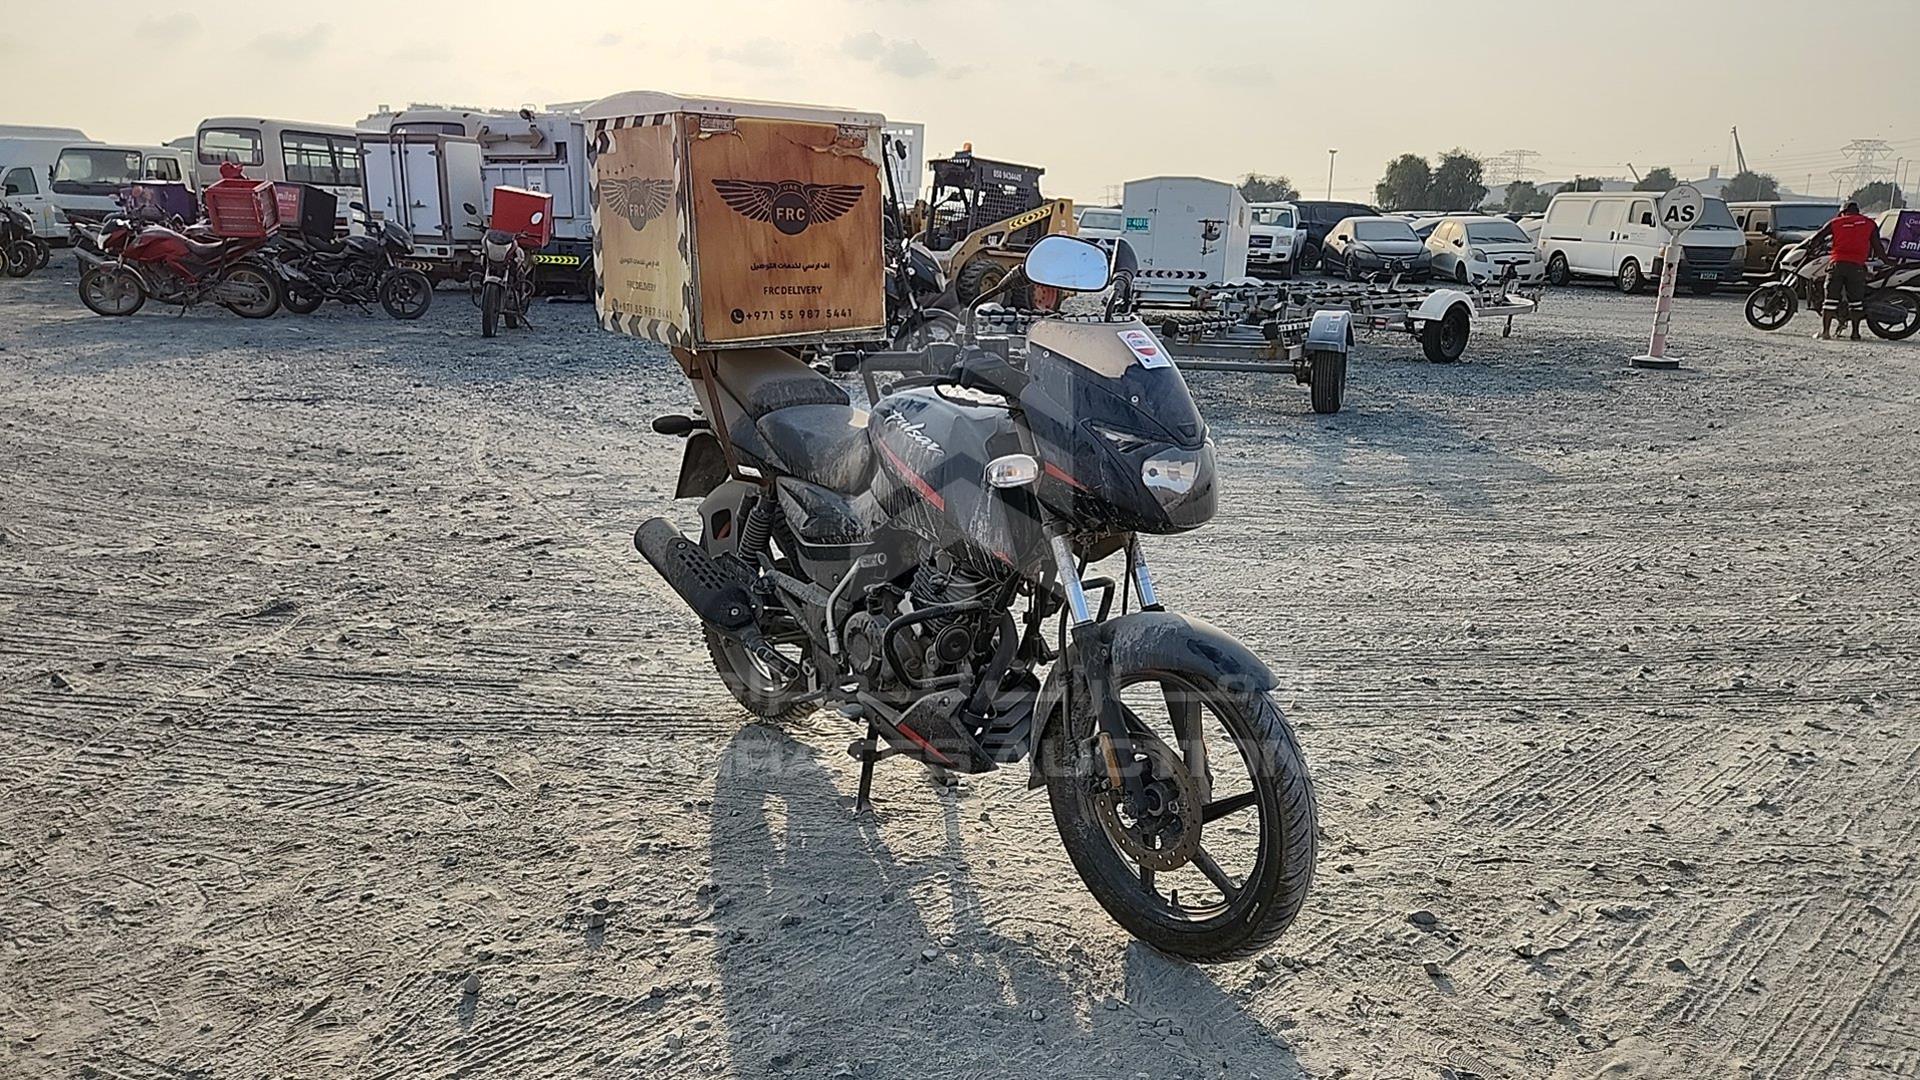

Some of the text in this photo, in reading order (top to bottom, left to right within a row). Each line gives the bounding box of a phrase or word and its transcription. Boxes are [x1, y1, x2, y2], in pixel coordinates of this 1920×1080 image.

[629, 203, 645, 217] FRC
[776, 207, 806, 221] FRC
[1664, 205, 1696, 223] AS
[746, 308, 852, 321] +971 55 987 5441
